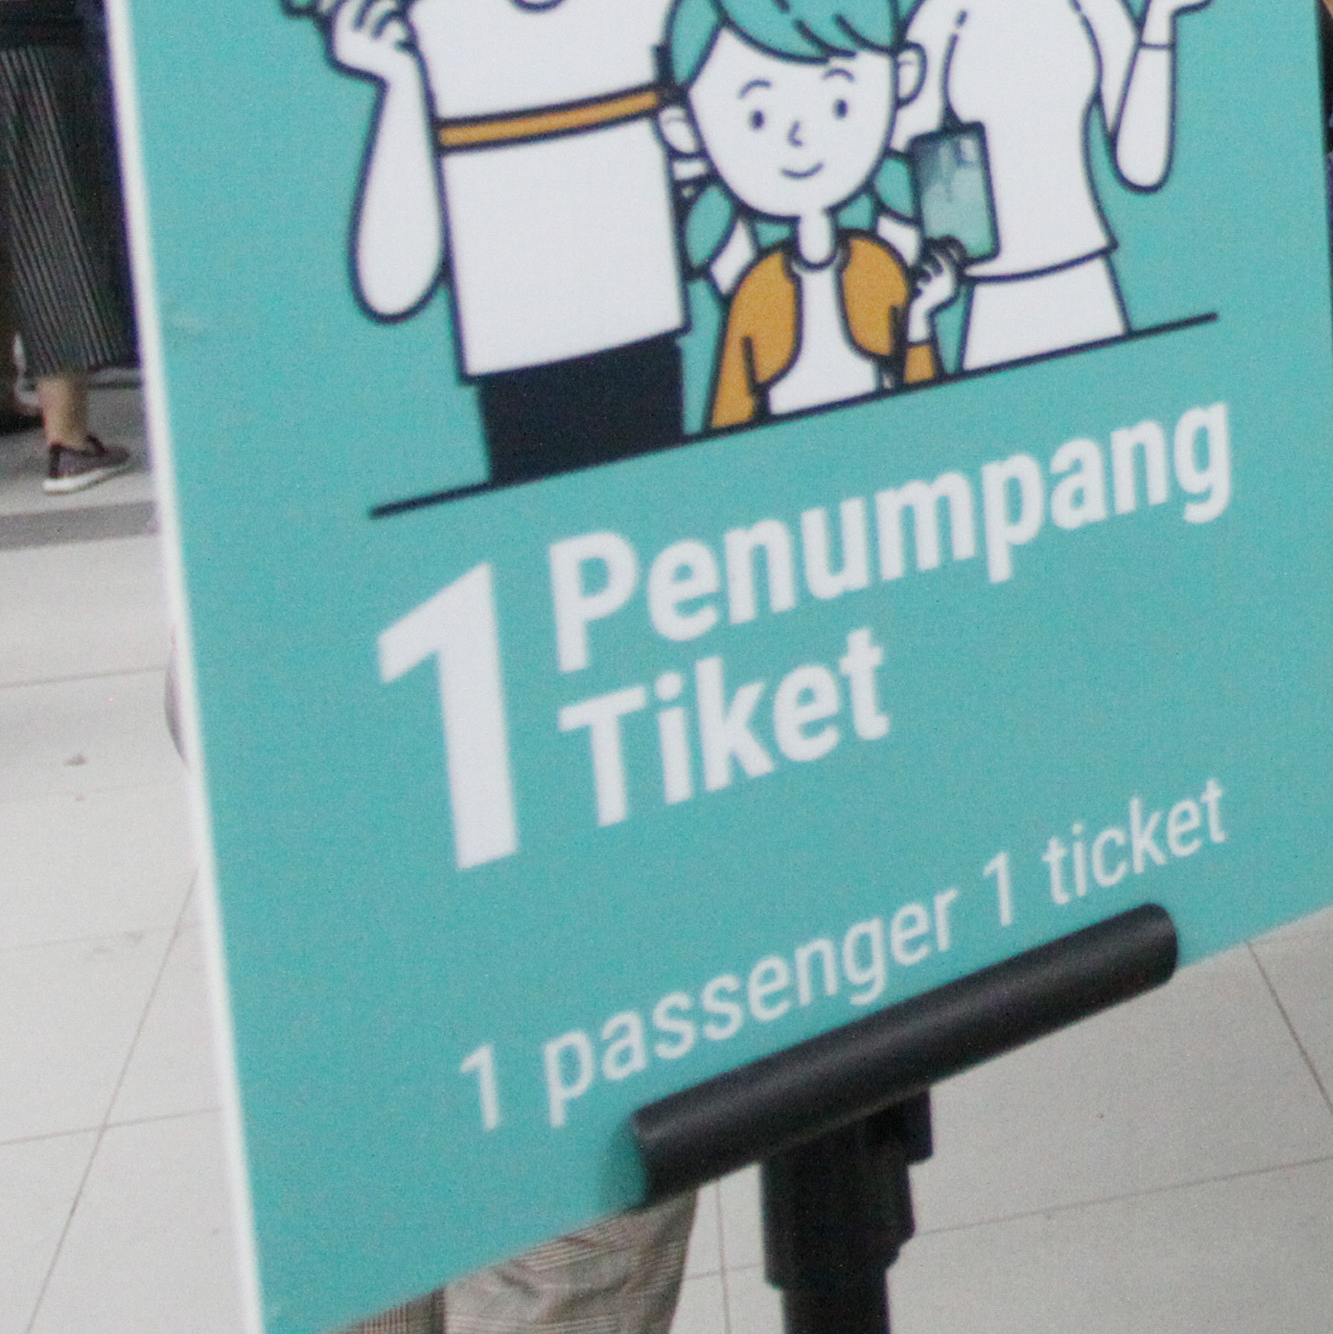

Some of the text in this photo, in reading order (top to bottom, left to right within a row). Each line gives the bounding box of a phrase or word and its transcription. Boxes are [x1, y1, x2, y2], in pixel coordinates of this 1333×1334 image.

[546, 400, 1234, 674] Penumpang
[375, 561, 520, 871] 1
[556, 626, 891, 827] Tiket
[459, 777, 1229, 1131] 1 passenger 1 ticket
